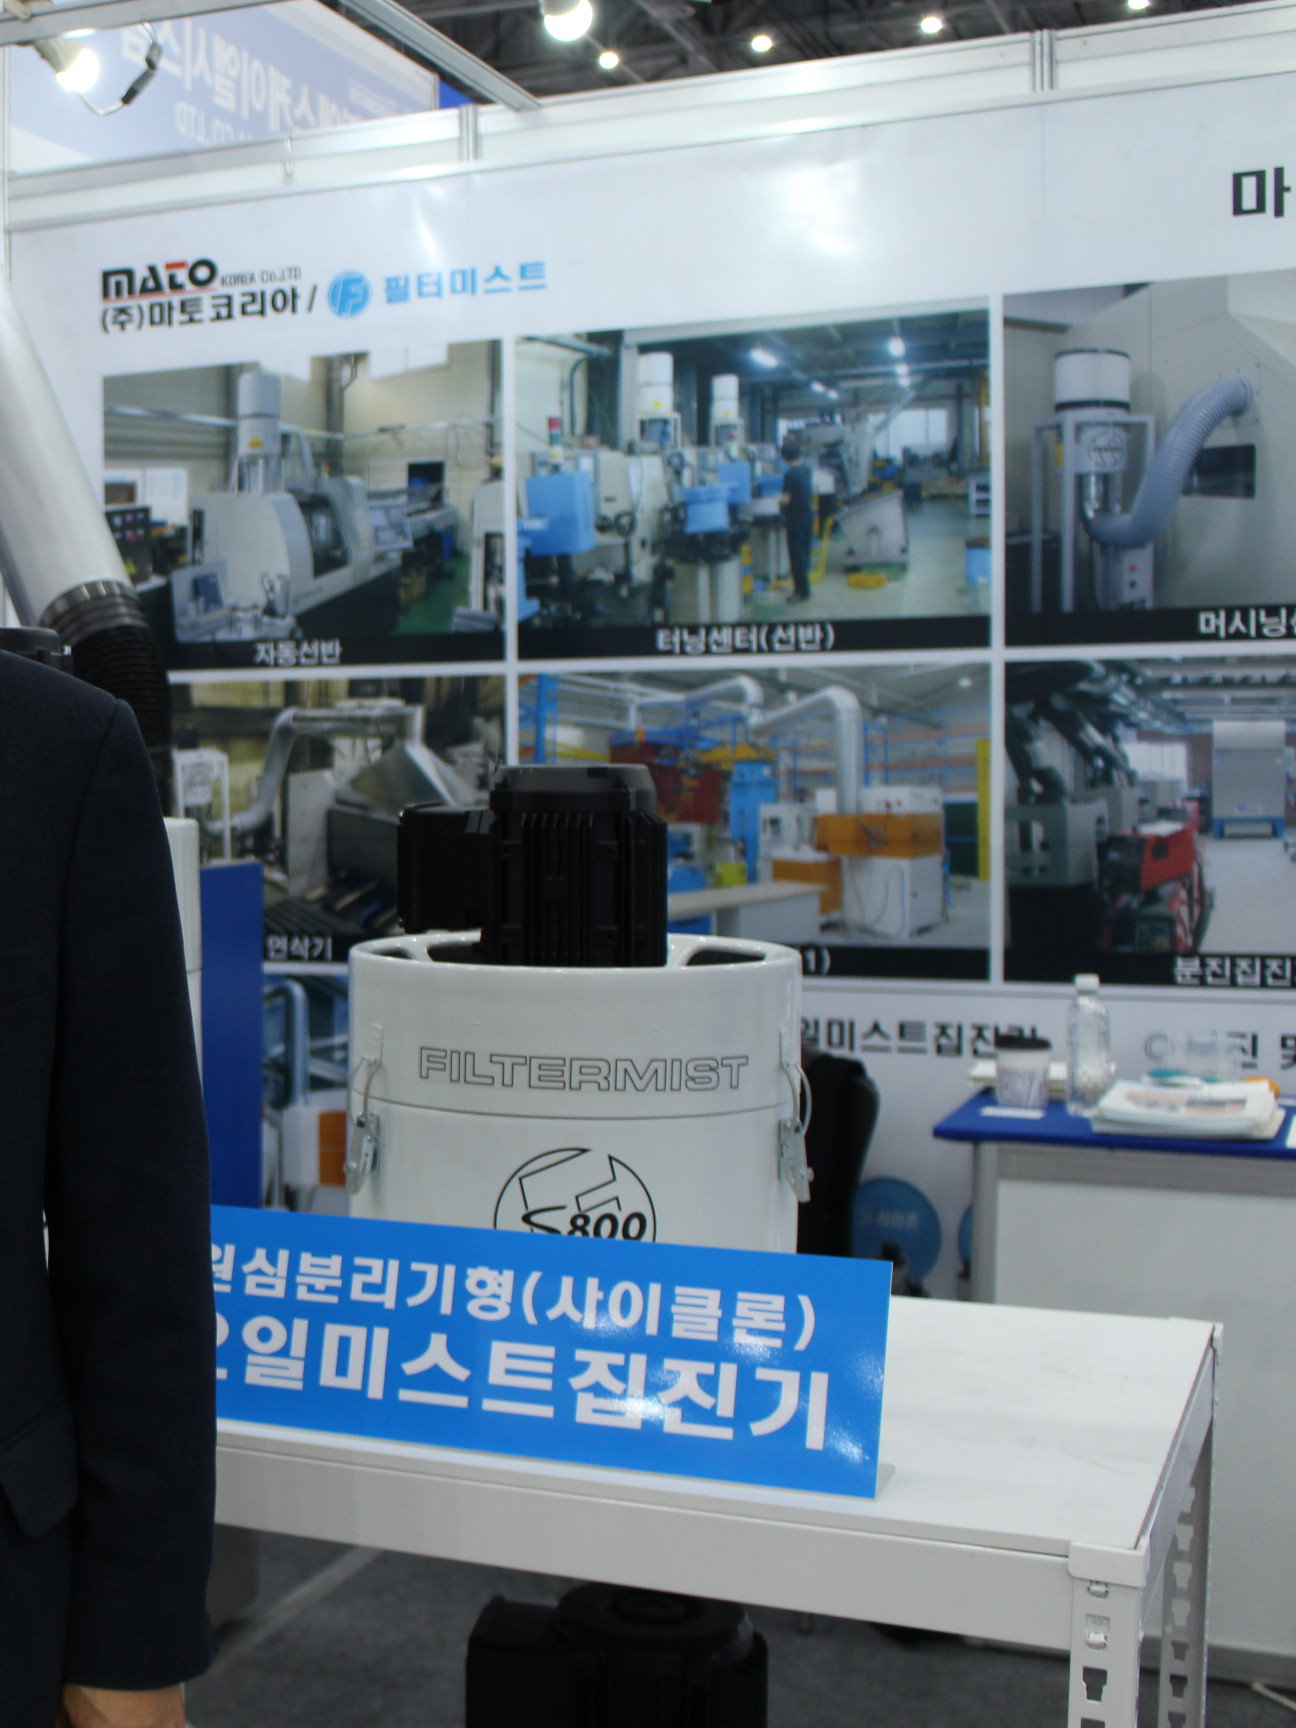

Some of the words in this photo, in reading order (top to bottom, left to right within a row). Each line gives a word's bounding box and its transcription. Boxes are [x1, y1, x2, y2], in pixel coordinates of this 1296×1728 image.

[1232, 166, 1292, 218] 마
[102, 258, 218, 299] MATO
[385, 261, 548, 305] 필터미스트
[656, 622, 835, 655] 터닝센터(선반)
[1199, 607, 1296, 638] 머시닝
[255, 639, 343, 667] 자동선반
[267, 934, 332, 961] 연삭기
[1175, 955, 1296, 987] 분진집진
[419, 1047, 749, 1092] FILTERMIST
